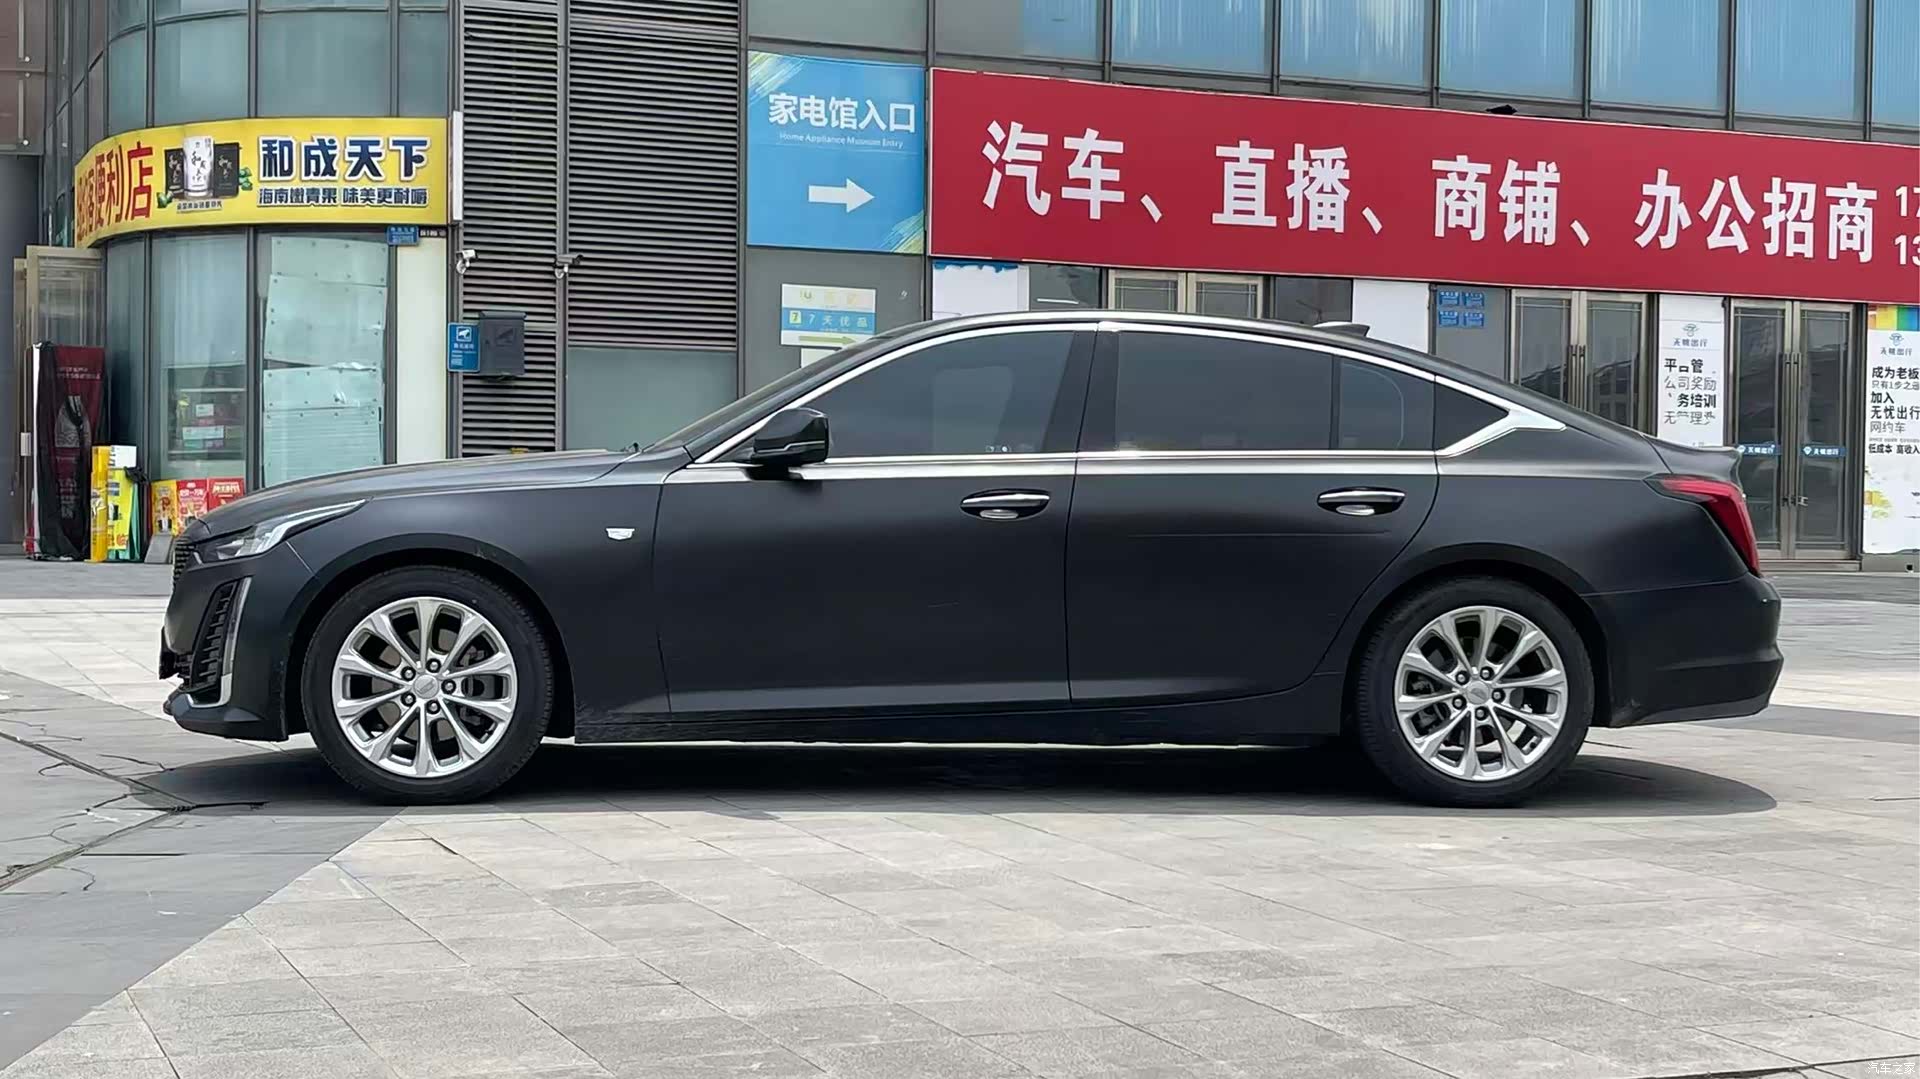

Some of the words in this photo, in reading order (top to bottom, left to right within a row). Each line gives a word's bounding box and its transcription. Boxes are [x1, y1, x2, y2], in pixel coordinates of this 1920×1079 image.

[769, 93, 915, 133] 家电馆入口
[780, 132, 804, 142] Home
[805, 133, 845, 145] Appliance
[259, 137, 430, 181] 和成天下
[1871, 366, 1919, 380] 成为老板
[1667, 393, 1716, 408] 务培训
[1870, 391, 1895, 404] 加入
[1870, 405, 1920, 420] 无忧出行
[1870, 421, 1906, 434] 网约车
